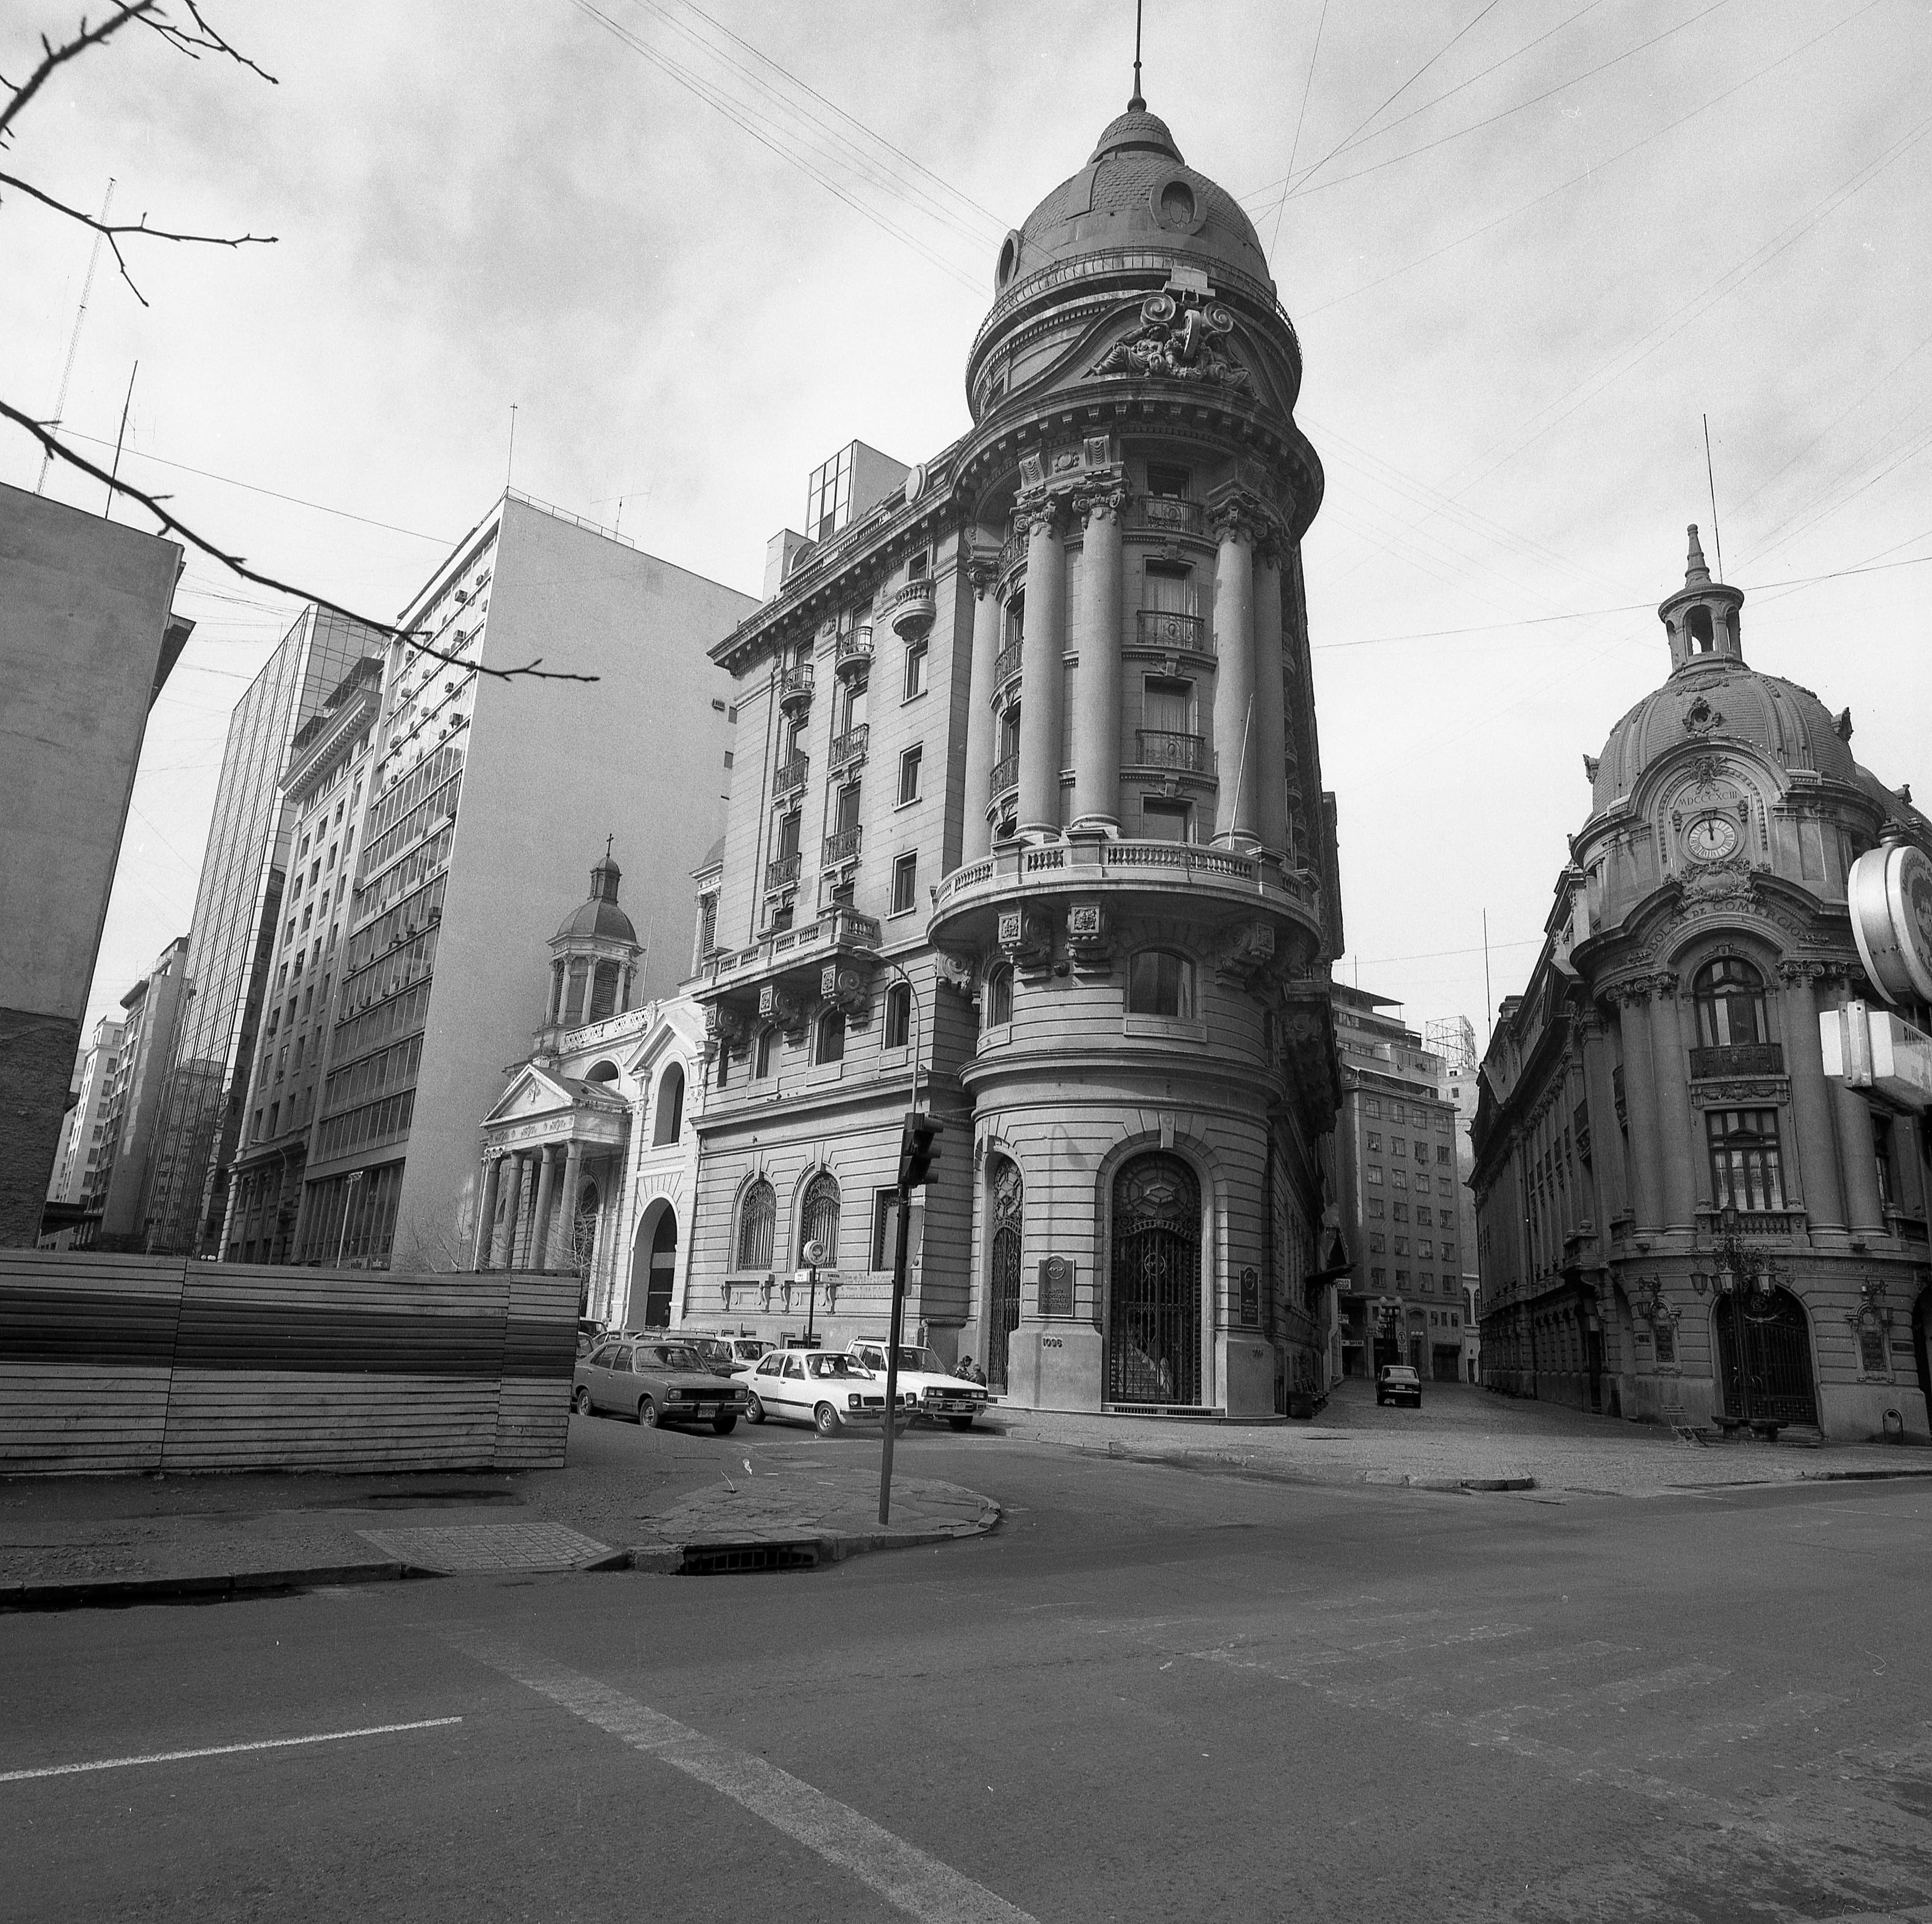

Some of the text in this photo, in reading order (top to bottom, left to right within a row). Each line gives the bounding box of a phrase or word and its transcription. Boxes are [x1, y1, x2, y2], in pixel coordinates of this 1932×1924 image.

[1648, 901, 1800, 951] BOLSA DE COMERCIO
